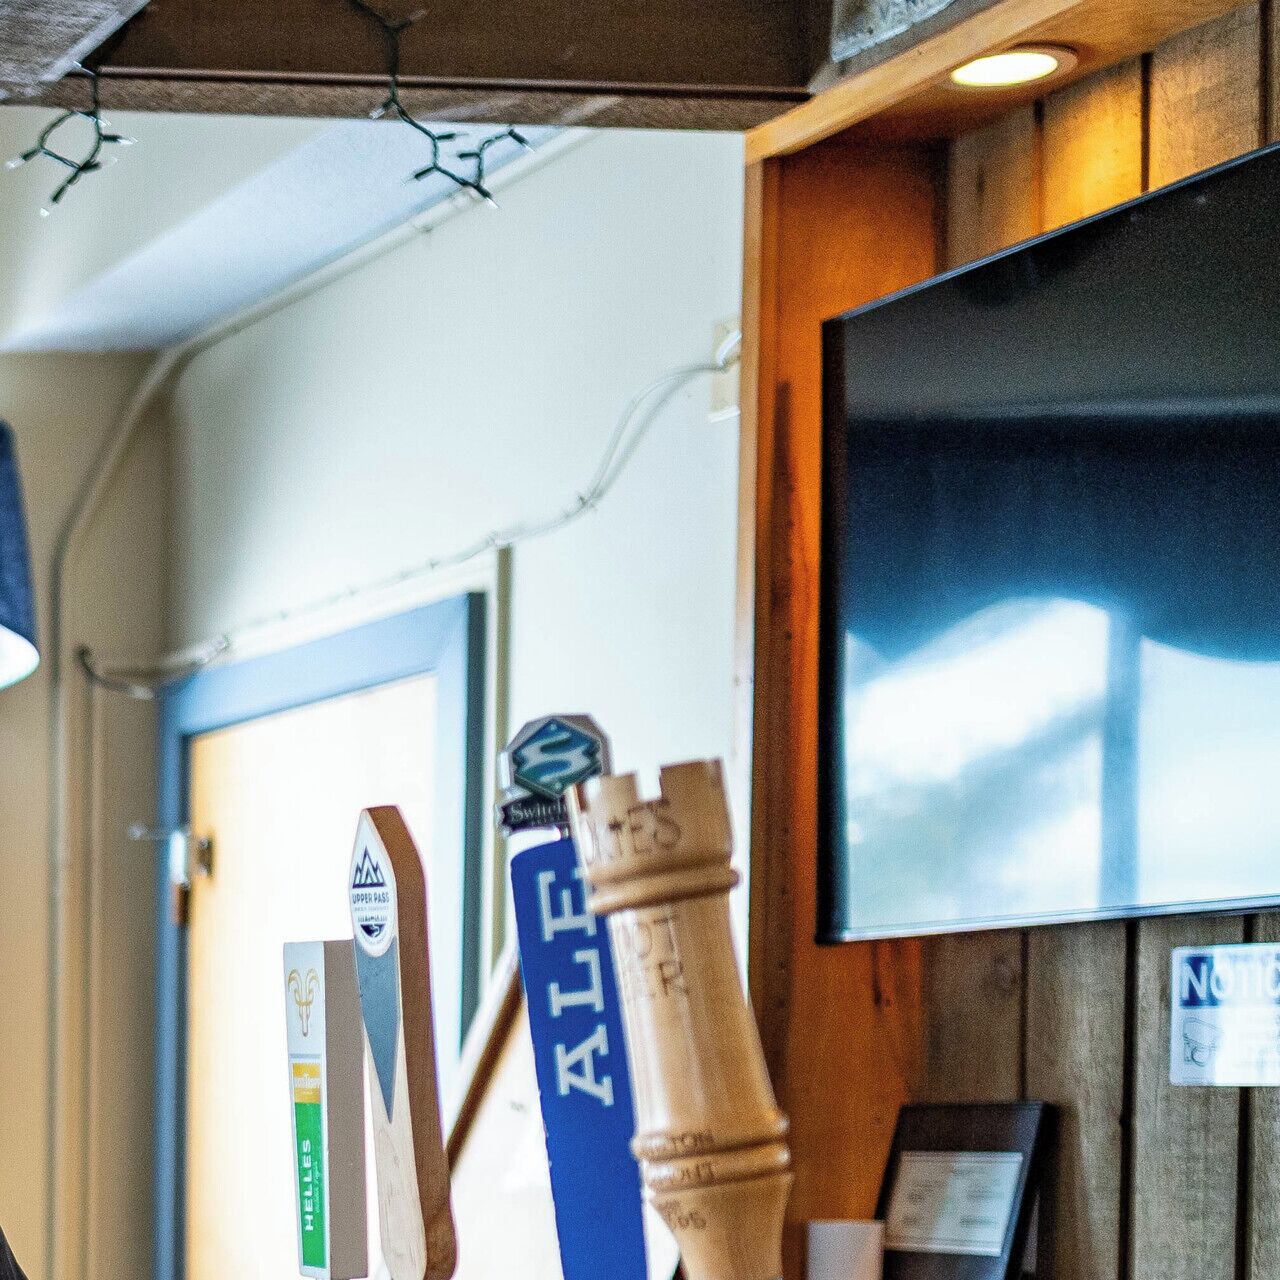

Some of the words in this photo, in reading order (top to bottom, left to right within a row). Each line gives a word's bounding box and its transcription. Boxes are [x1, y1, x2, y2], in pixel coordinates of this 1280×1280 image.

[509, 802, 568, 821] Switch
[352, 892, 373, 904] UPPER
[374, 892, 389, 903] PASS
[538, 866, 615, 1107] ALE
[1181, 961, 1280, 1001] NOTIC
[302, 1139, 314, 1231] HELLES
